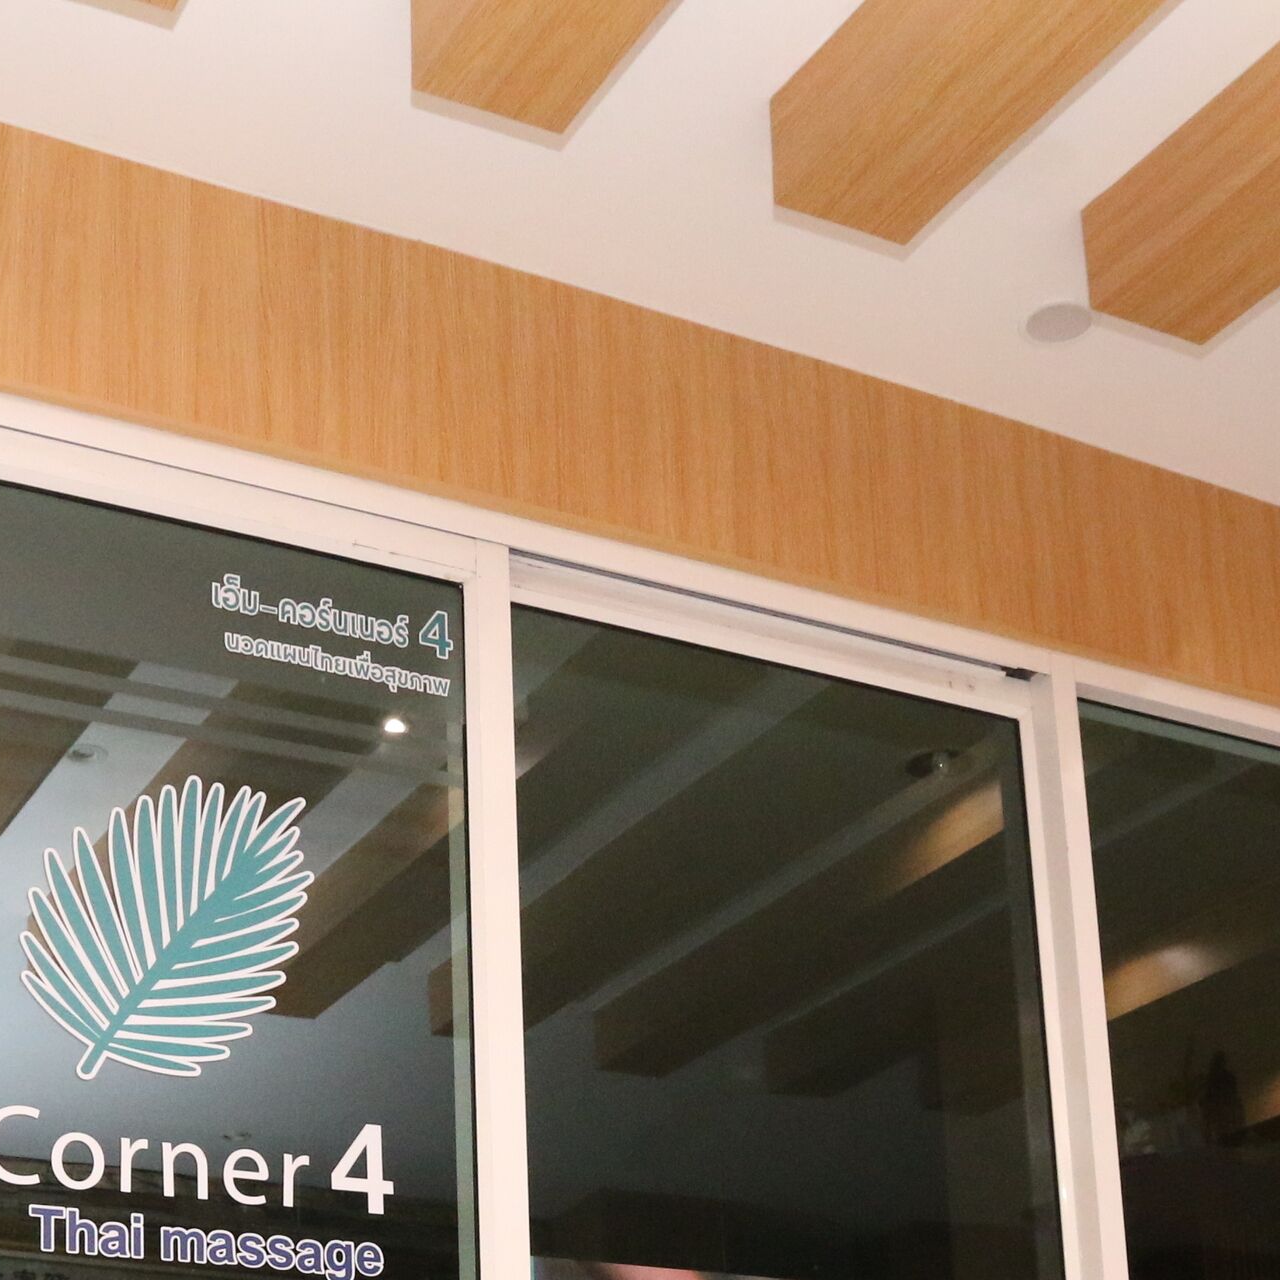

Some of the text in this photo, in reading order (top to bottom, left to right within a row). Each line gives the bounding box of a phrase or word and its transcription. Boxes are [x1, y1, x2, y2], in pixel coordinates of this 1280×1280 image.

[224, 631, 451, 697] นวดแผนไทยเพื่อสุขภาพ
[419, 610, 453, 659] 4
[331, 1123, 395, 1215] 4
[28, 1204, 144, 1260] Thai
